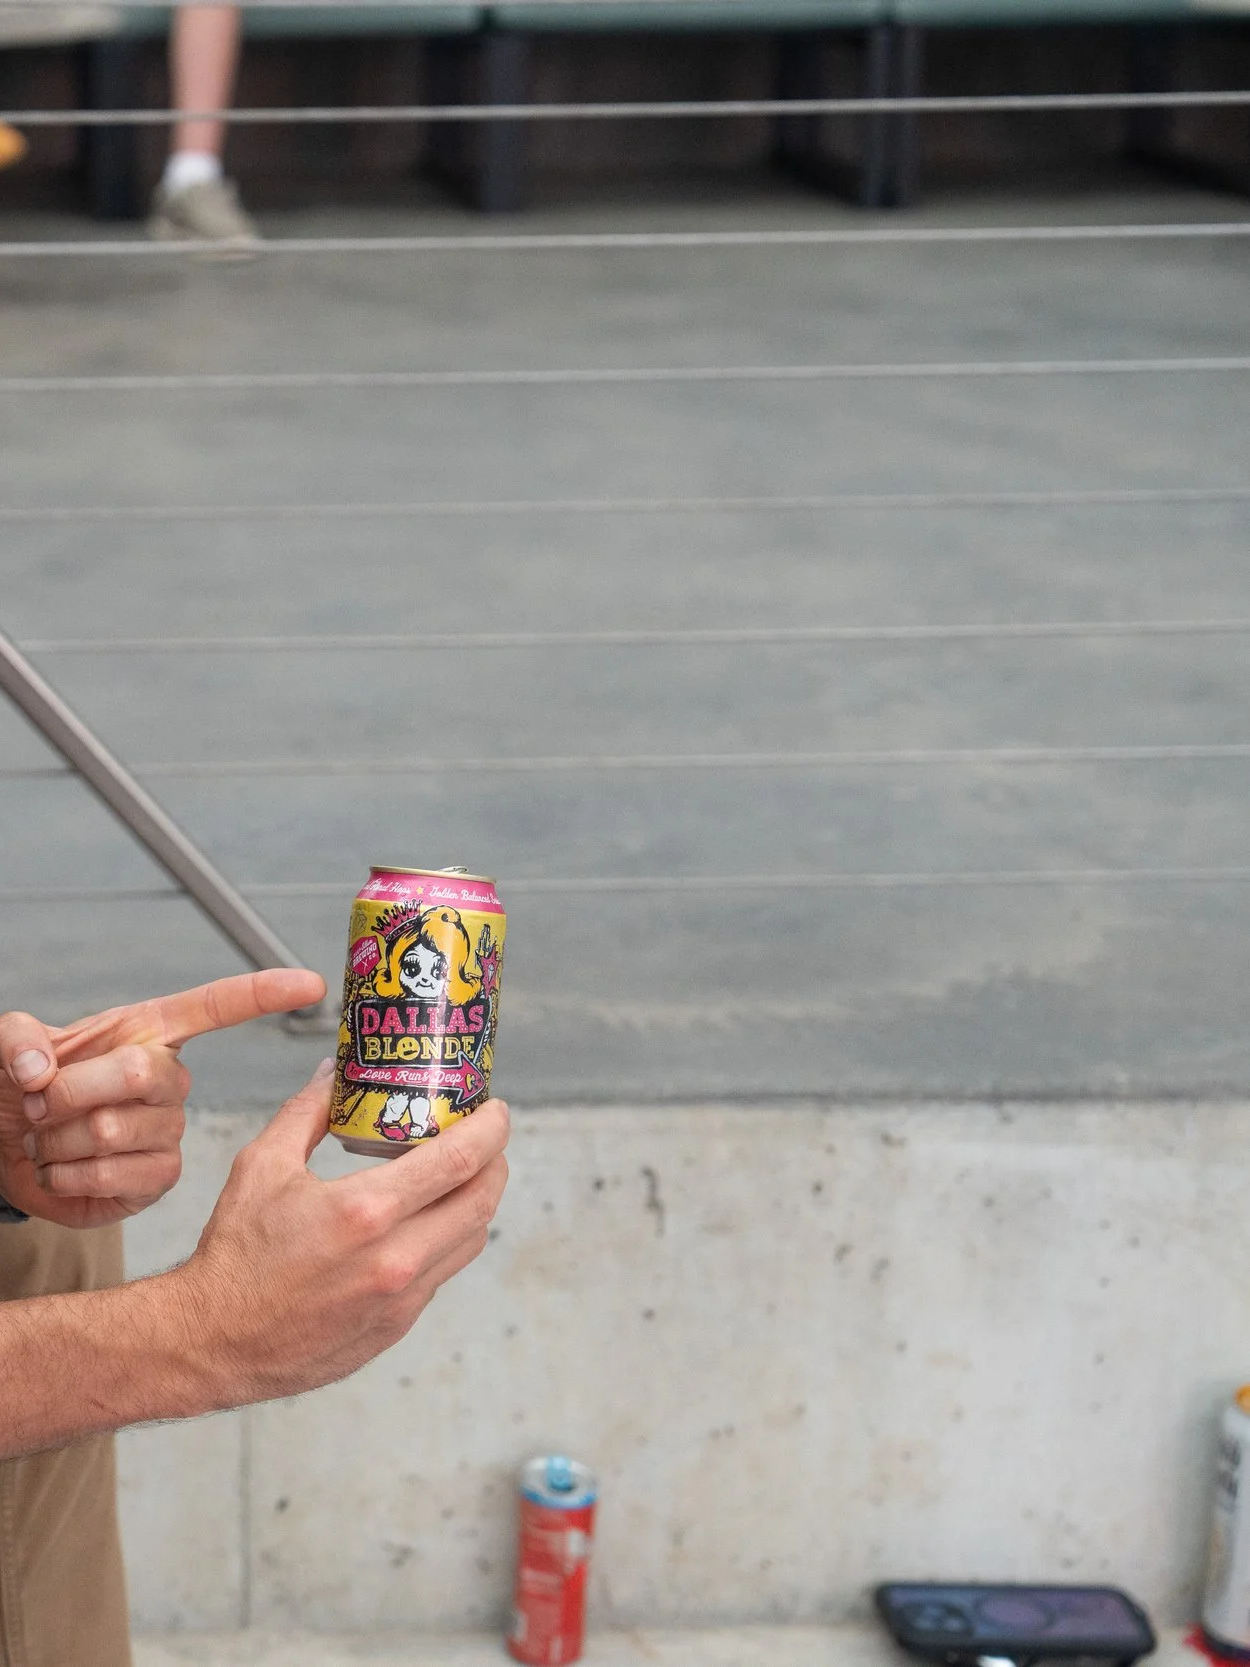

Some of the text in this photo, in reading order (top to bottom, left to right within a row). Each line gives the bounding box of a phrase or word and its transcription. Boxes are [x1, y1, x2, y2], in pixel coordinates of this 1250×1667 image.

[429, 886, 459, 900] Golden
[361, 1005, 484, 1034] DALLAS
[365, 1036, 475, 1060] BLONDE
[359, 1069, 392, 1080] Love
[395, 1070, 431, 1083] Runs
[431, 1070, 464, 1087] Deep
